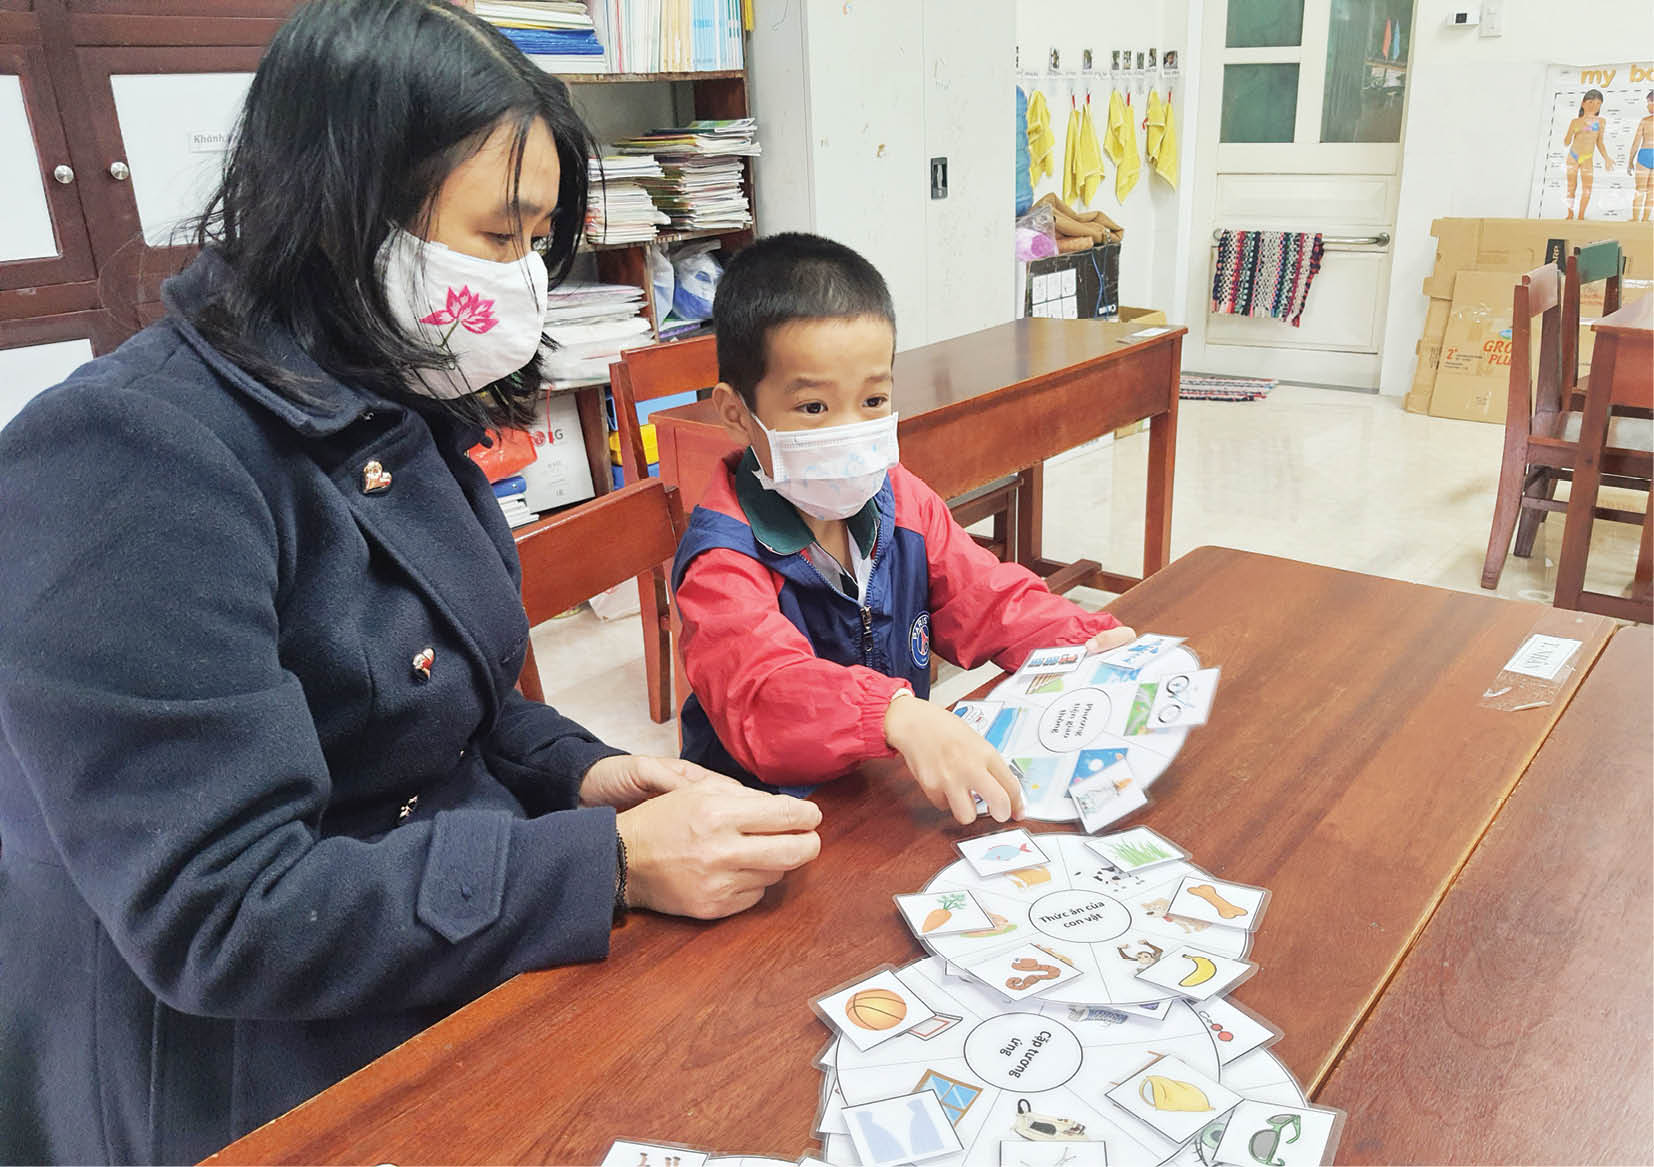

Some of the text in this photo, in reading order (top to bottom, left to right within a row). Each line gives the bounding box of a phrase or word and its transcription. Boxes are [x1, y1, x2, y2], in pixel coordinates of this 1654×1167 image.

[1580, 69, 1616, 88] my
[1040, 912, 1069, 923] Thức
[1086, 901, 1105, 911] của
[1063, 912, 1103, 928] con vật
[1000, 1038, 1023, 1056] ứng
[1008, 1031, 1052, 1078] Cặp tương
